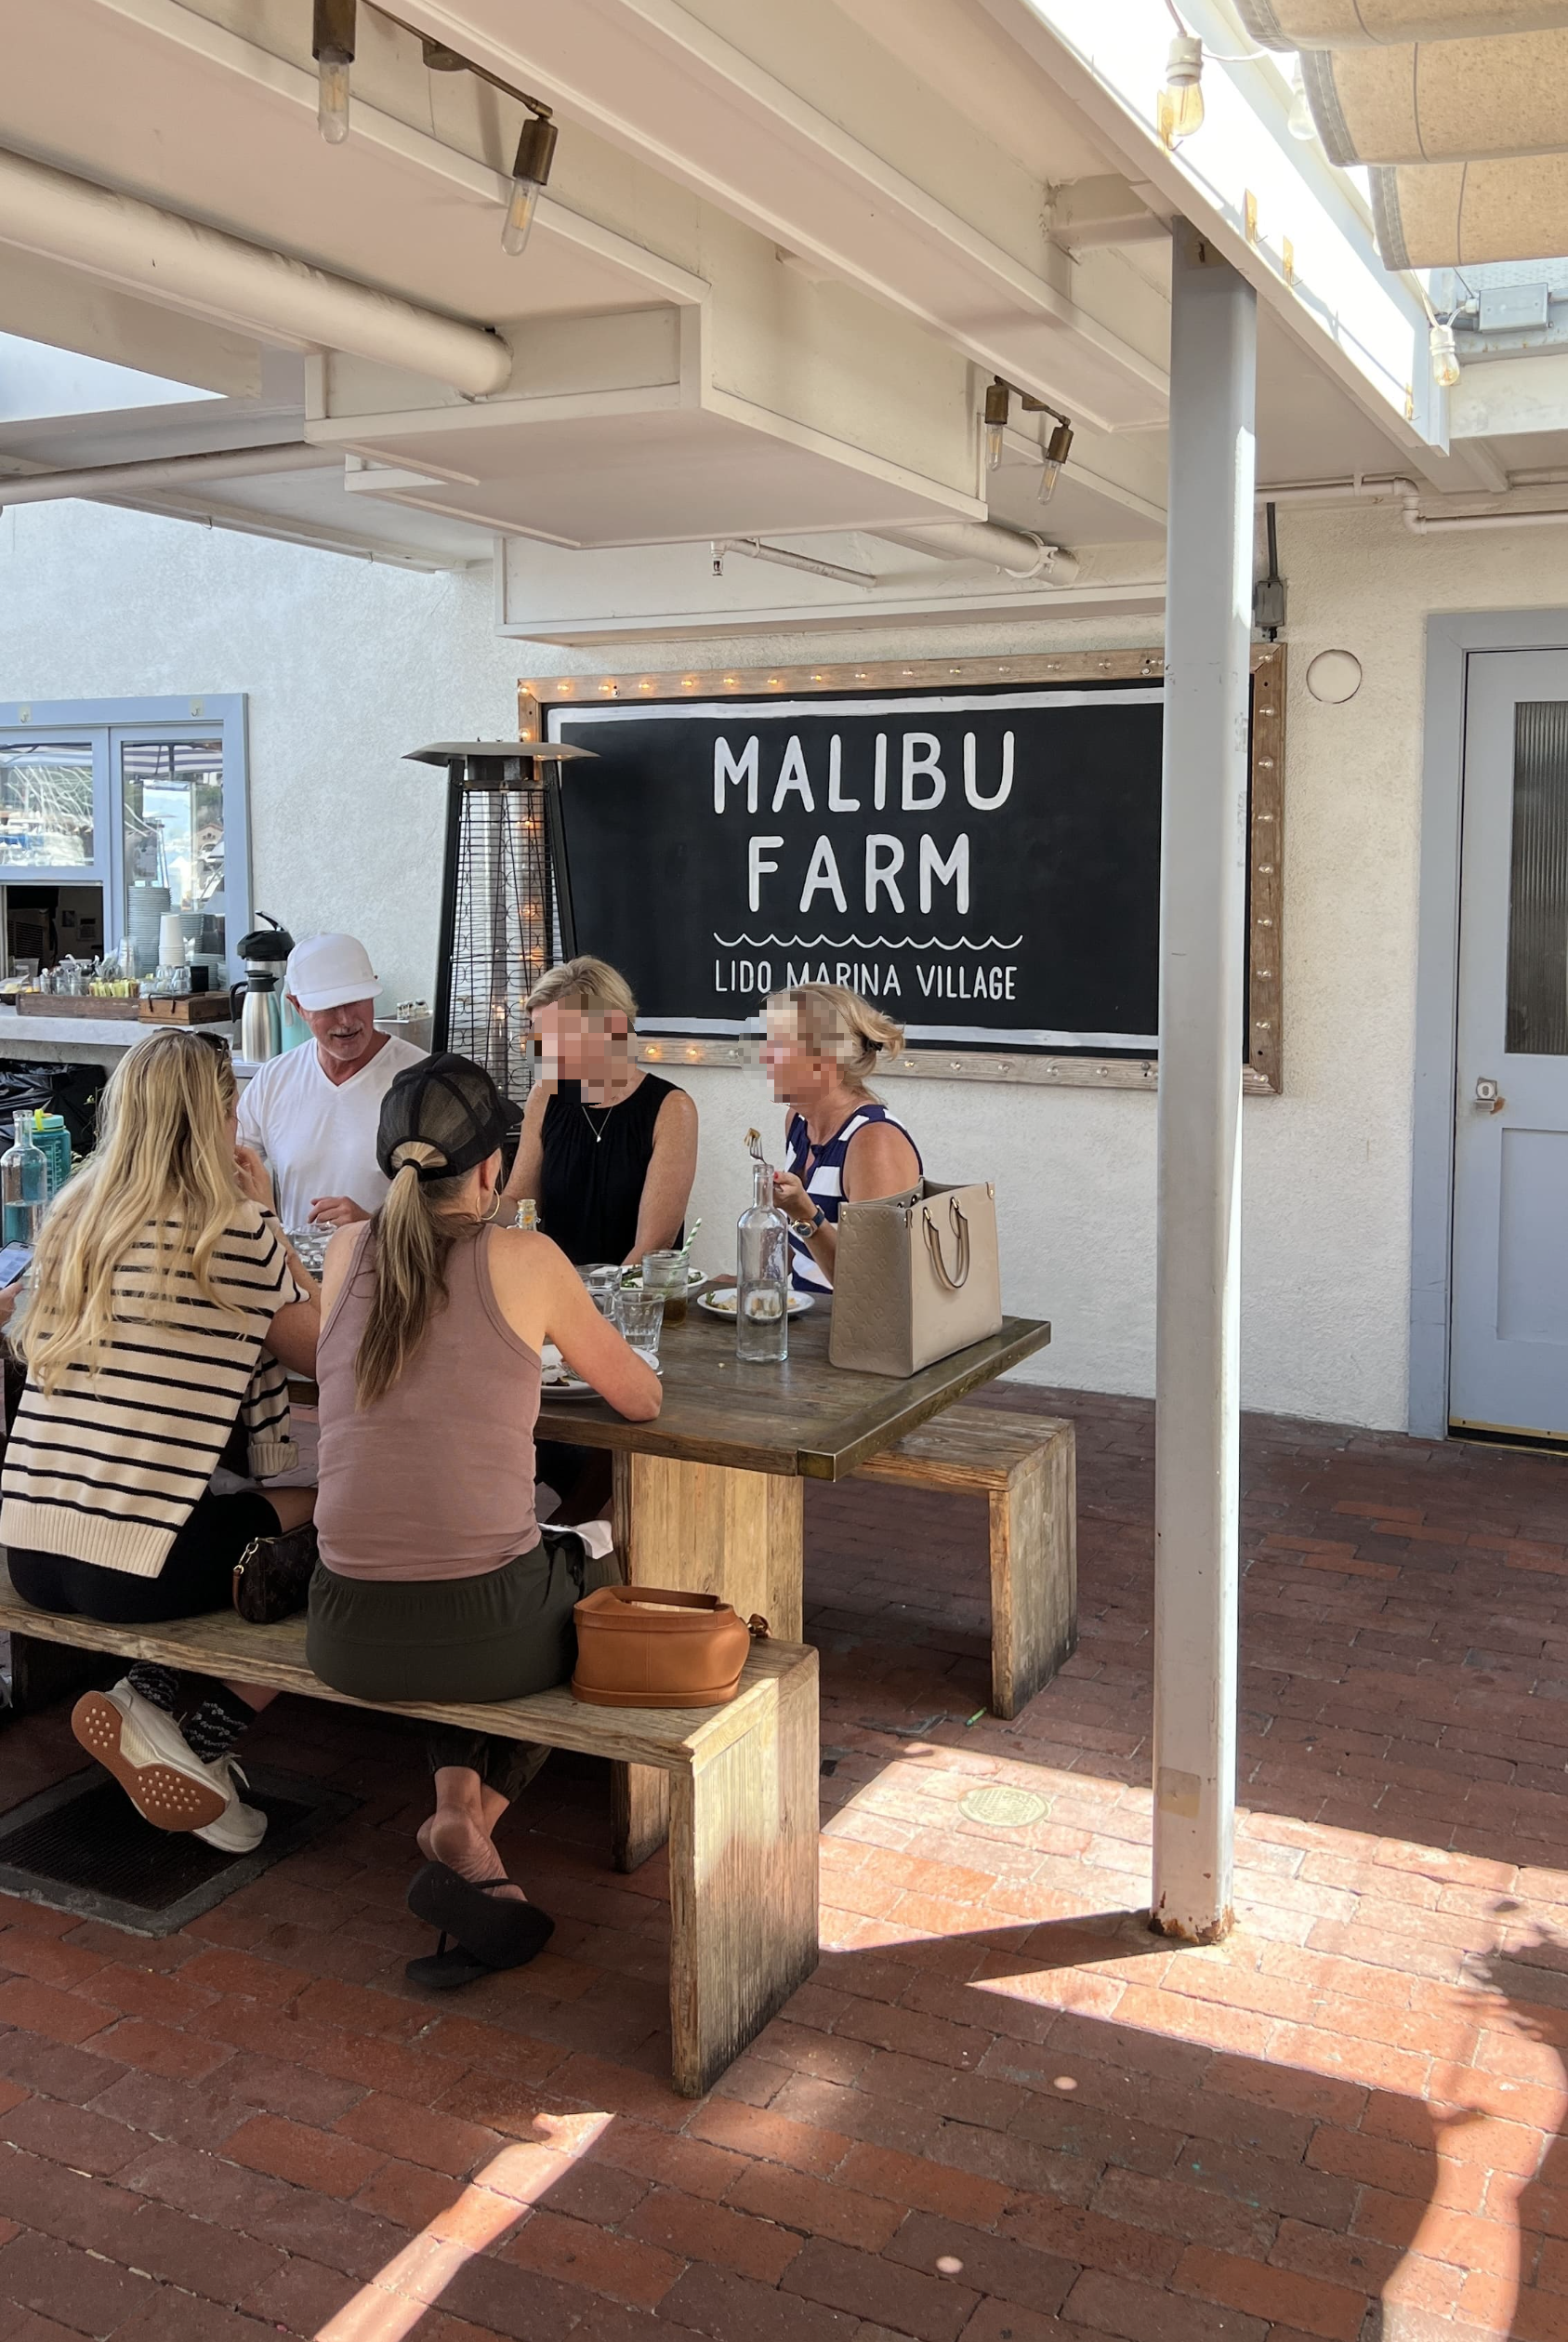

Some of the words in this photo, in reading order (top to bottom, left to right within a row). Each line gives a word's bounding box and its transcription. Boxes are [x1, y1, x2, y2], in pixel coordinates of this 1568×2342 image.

[713, 730, 1016, 814] MALIBU
[747, 832, 970, 915] FARM
[715, 959, 772, 994] LIDO
[785, 961, 902, 997] MARINA
[916, 964, 1018, 1000] VILLAGE
